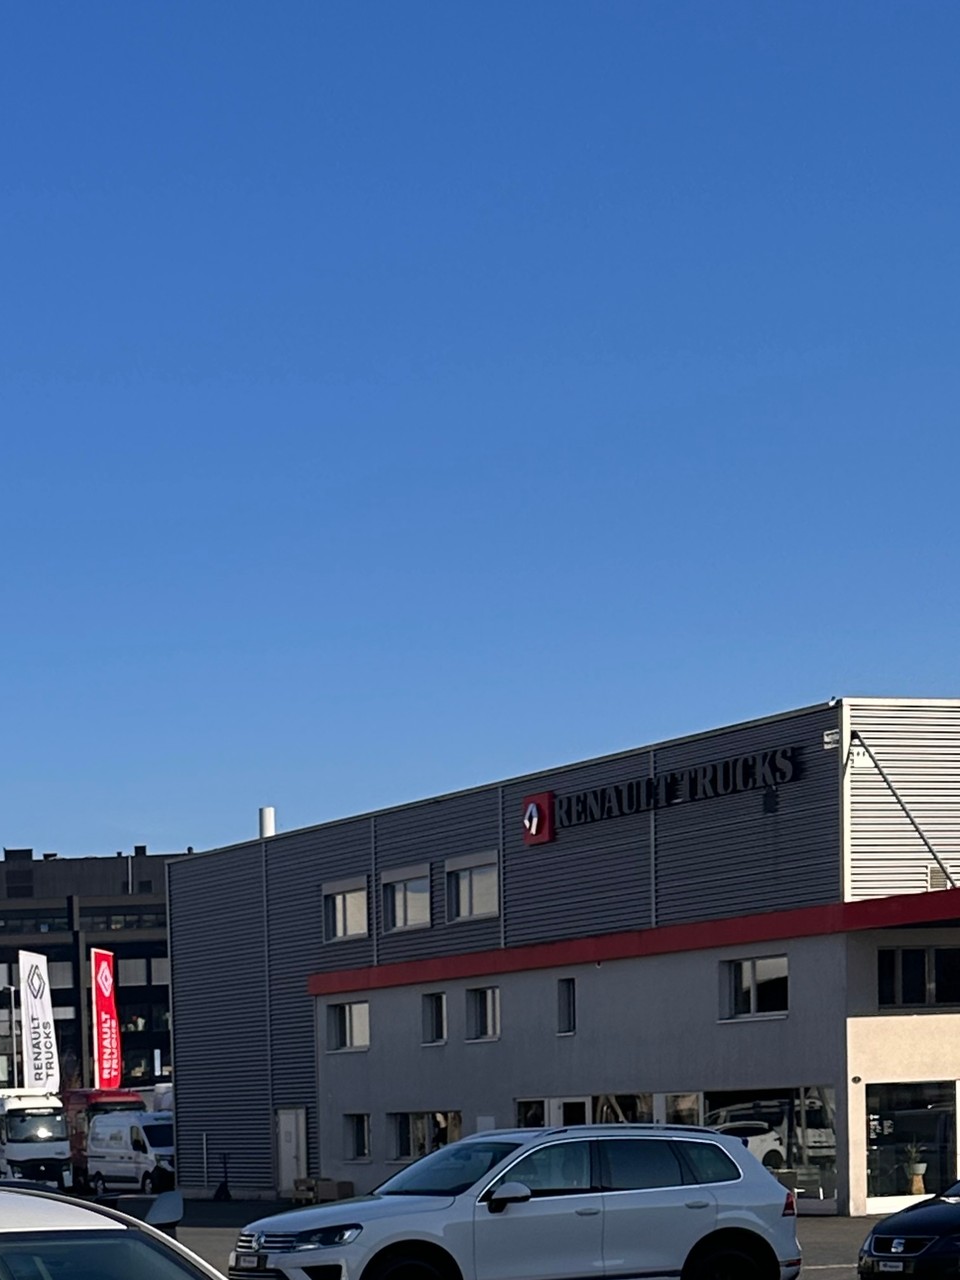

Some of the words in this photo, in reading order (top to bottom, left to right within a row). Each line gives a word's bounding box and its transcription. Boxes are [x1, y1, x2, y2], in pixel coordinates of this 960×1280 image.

[555, 774, 671, 828] RENAULT
[681, 750, 794, 800] TRUCKS
[31, 1015, 44, 1081] RENAULT
[42, 1021, 54, 1079] TRUCKS
[101, 1012, 111, 1079] RENAULT
